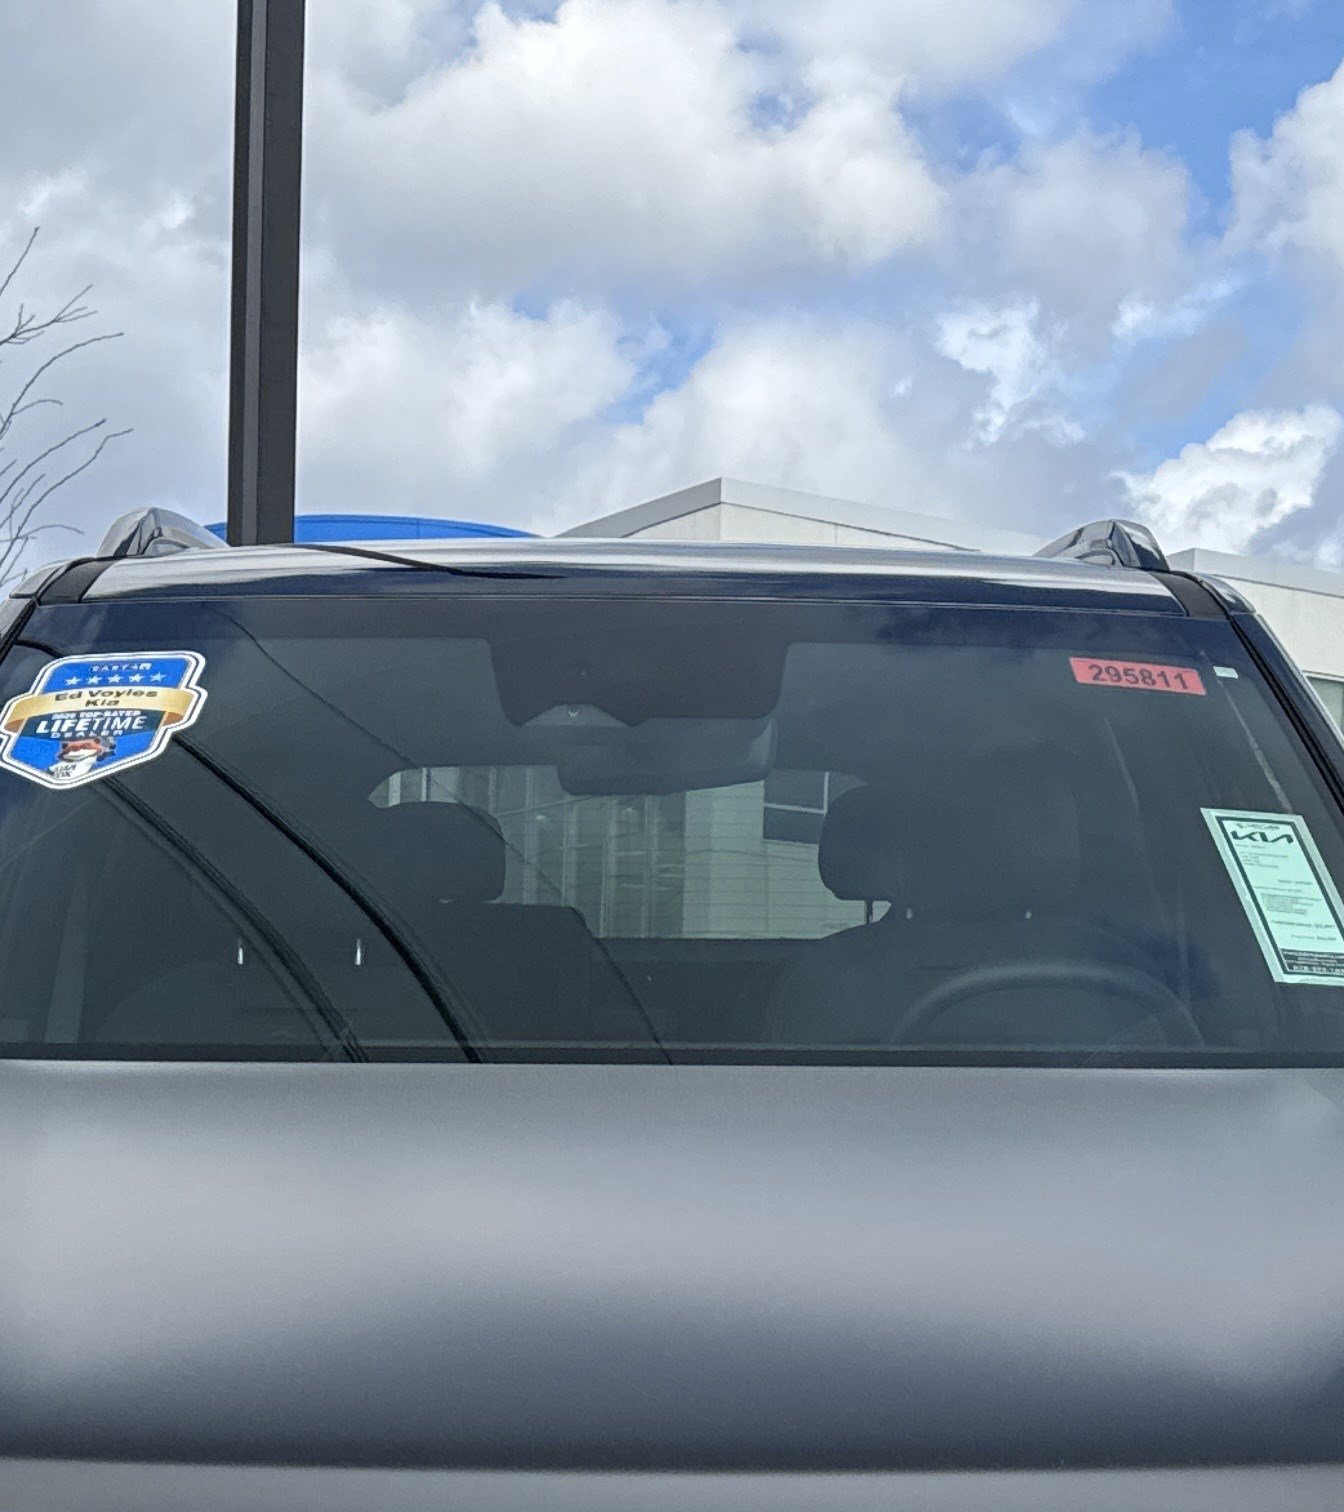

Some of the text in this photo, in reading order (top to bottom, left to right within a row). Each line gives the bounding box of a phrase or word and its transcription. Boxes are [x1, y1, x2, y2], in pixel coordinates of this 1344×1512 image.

[1088, 663, 1189, 690] 295811
[55, 688, 158, 701] Ed Voyles
[85, 699, 120, 707] Kia
[36, 715, 147, 734] LIFETIME
[1230, 830, 1294, 844] KIA
